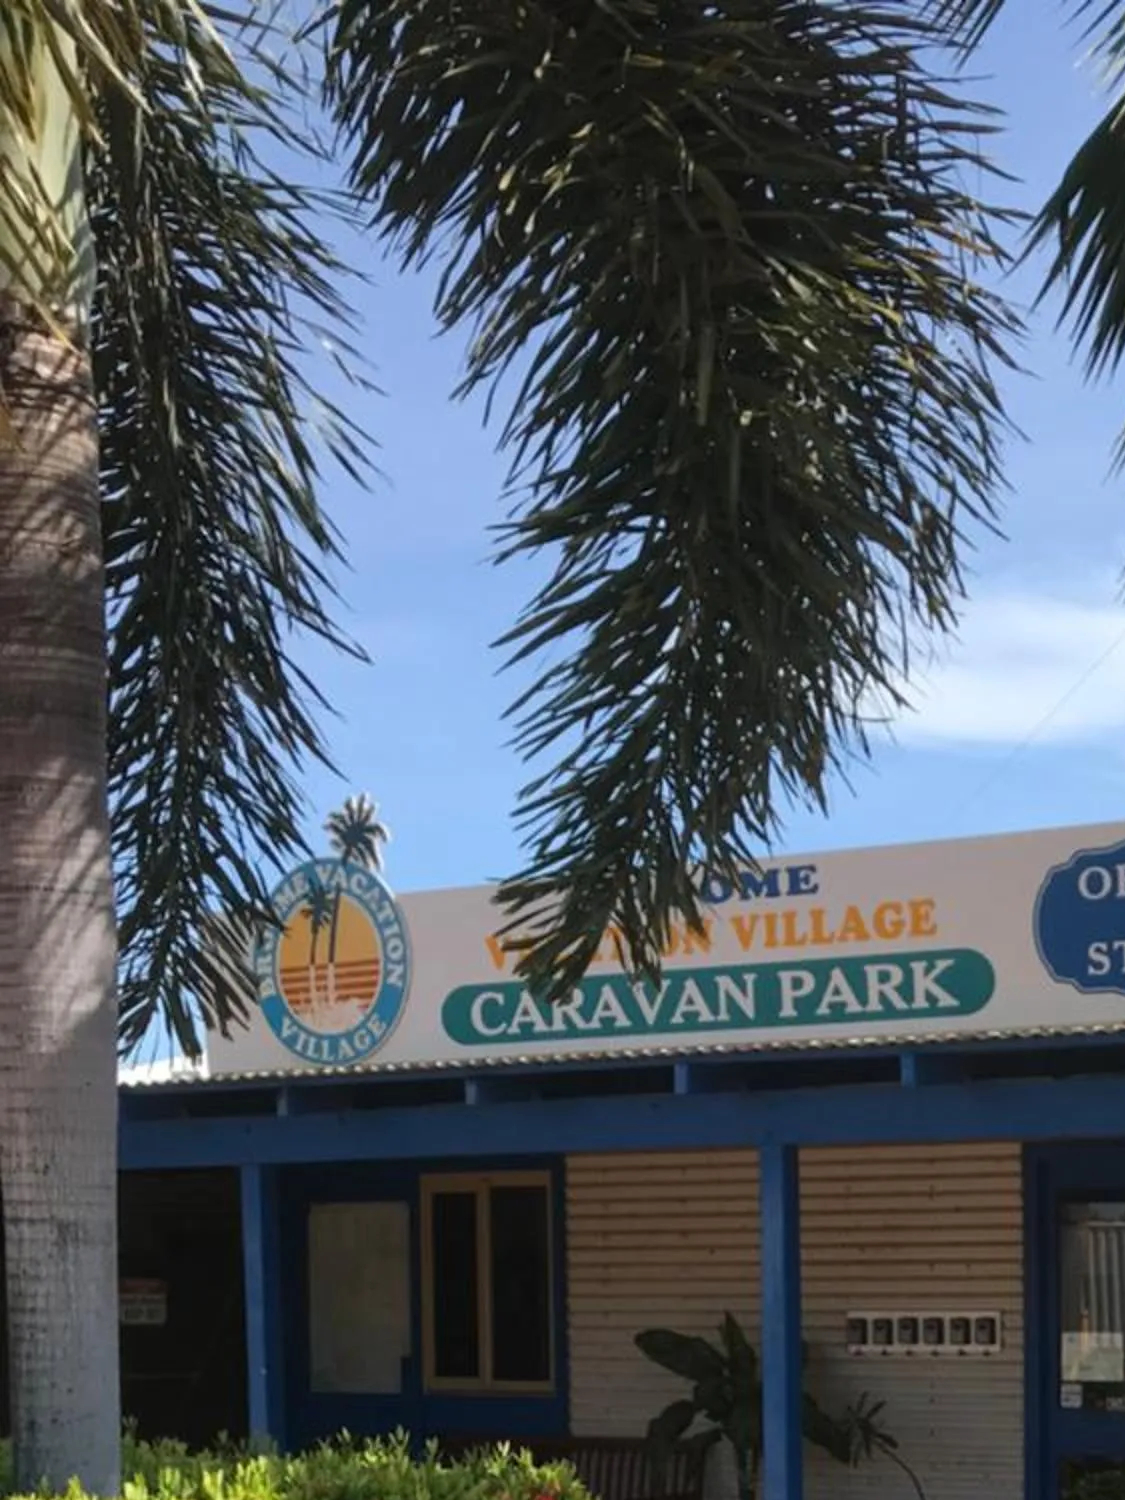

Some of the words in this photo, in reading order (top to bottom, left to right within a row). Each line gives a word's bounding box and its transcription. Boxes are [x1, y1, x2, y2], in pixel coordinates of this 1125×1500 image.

[314, 862, 404, 988] VACATION
[730, 897, 938, 953] VILLAGE
[469, 971, 760, 1036] CARAVAN
[777, 957, 961, 1019] PARK
[280, 1013, 387, 1063] VILLAGE
